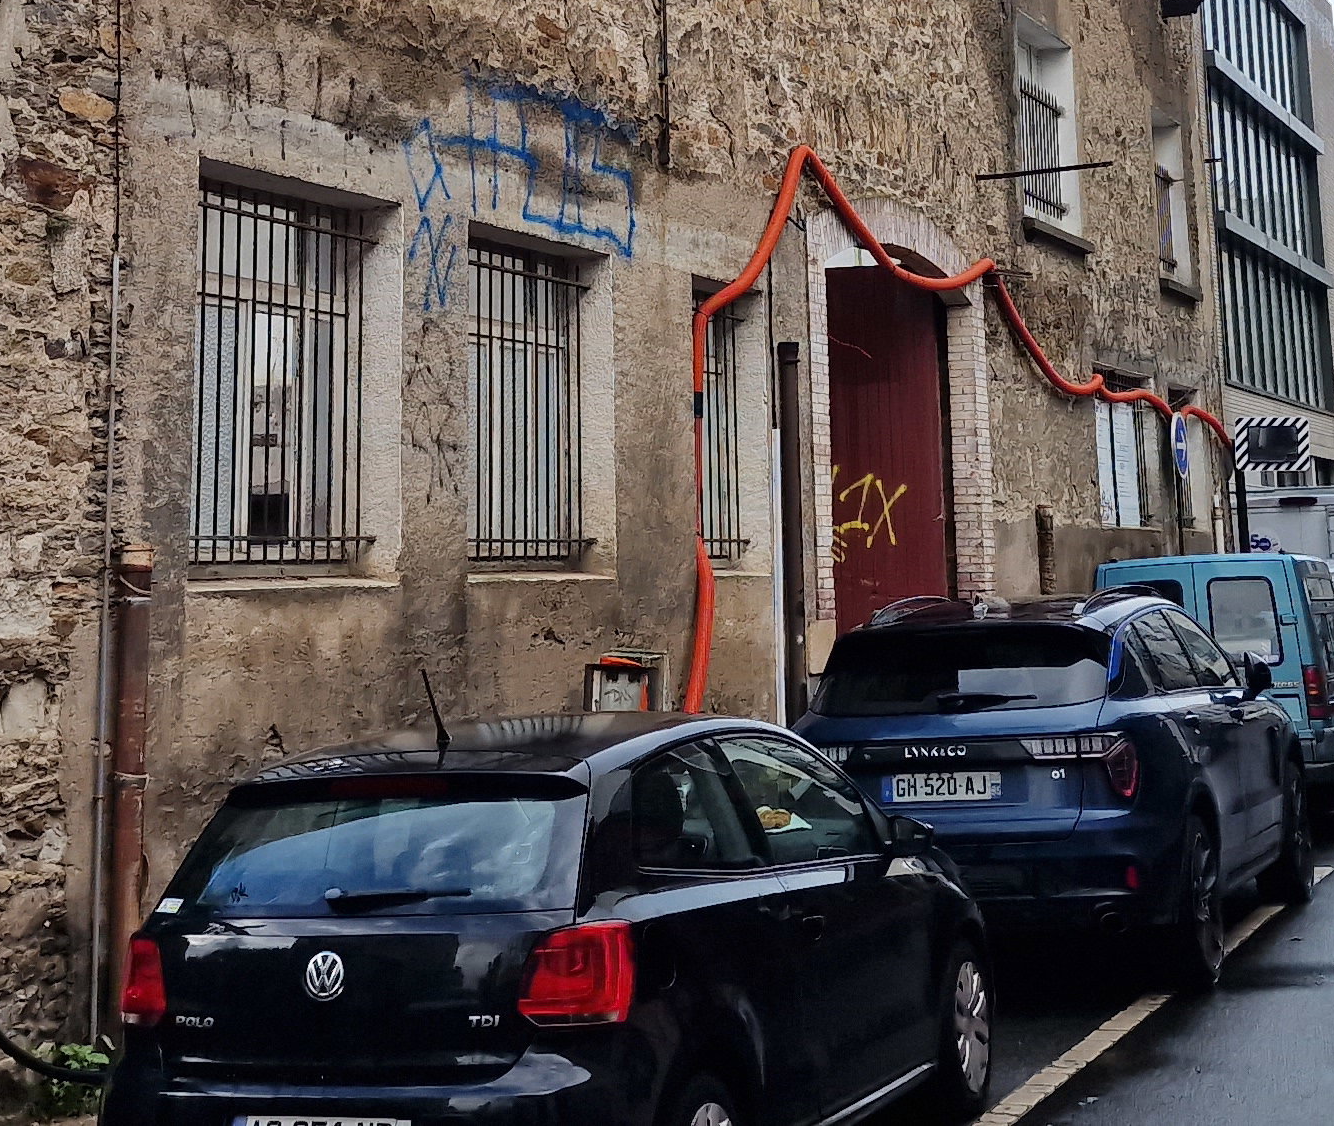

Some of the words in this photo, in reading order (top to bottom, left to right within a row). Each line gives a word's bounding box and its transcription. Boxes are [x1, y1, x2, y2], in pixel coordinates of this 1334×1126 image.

[896, 776, 987, 797] GH-520-AJ
[175, 1015, 214, 1027] POLO
[469, 1015, 500, 1028] TDI
